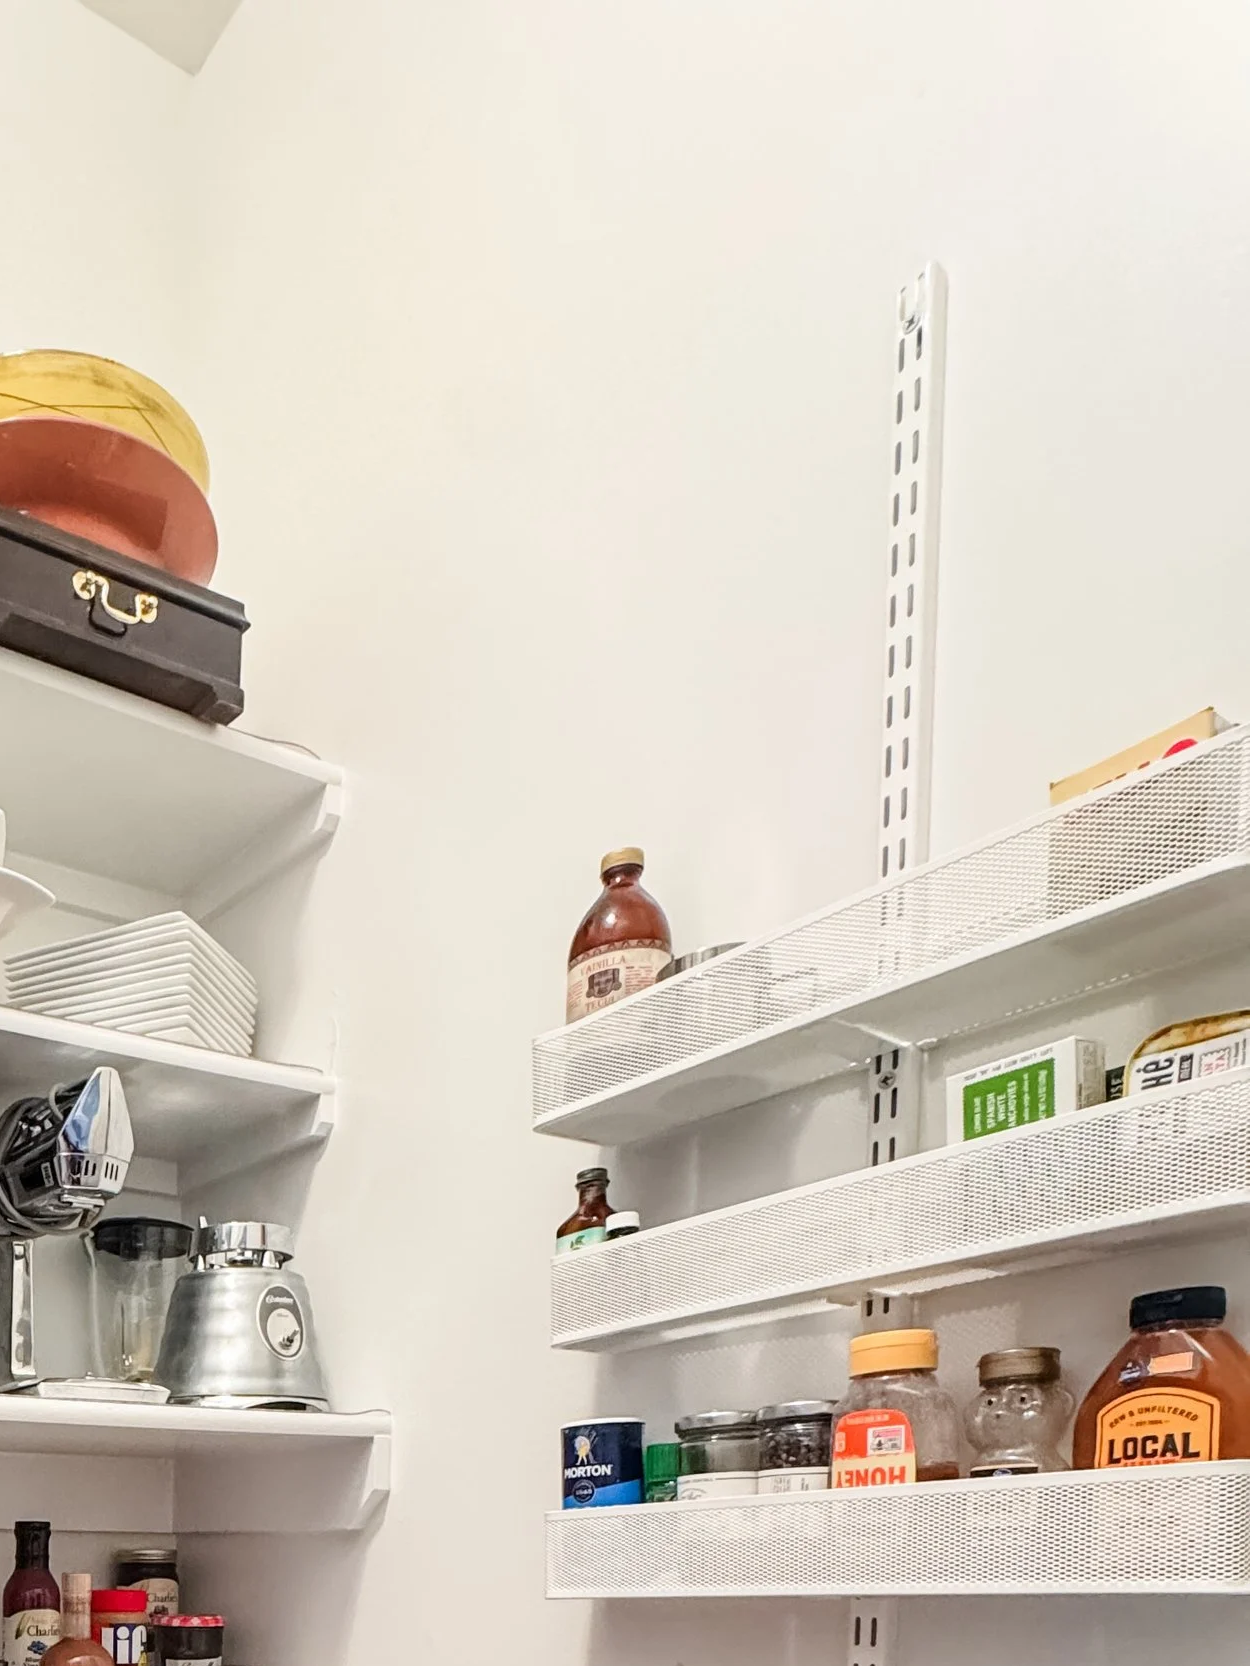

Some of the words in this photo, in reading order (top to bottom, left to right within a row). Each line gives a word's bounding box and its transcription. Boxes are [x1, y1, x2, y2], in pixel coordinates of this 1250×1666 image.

[1137, 1405, 1199, 1422] UNFILTERED
[1108, 1431, 1200, 1465] LOCAL
[564, 1464, 614, 1479] MORTON
[836, 1465, 906, 1488] HONEY
